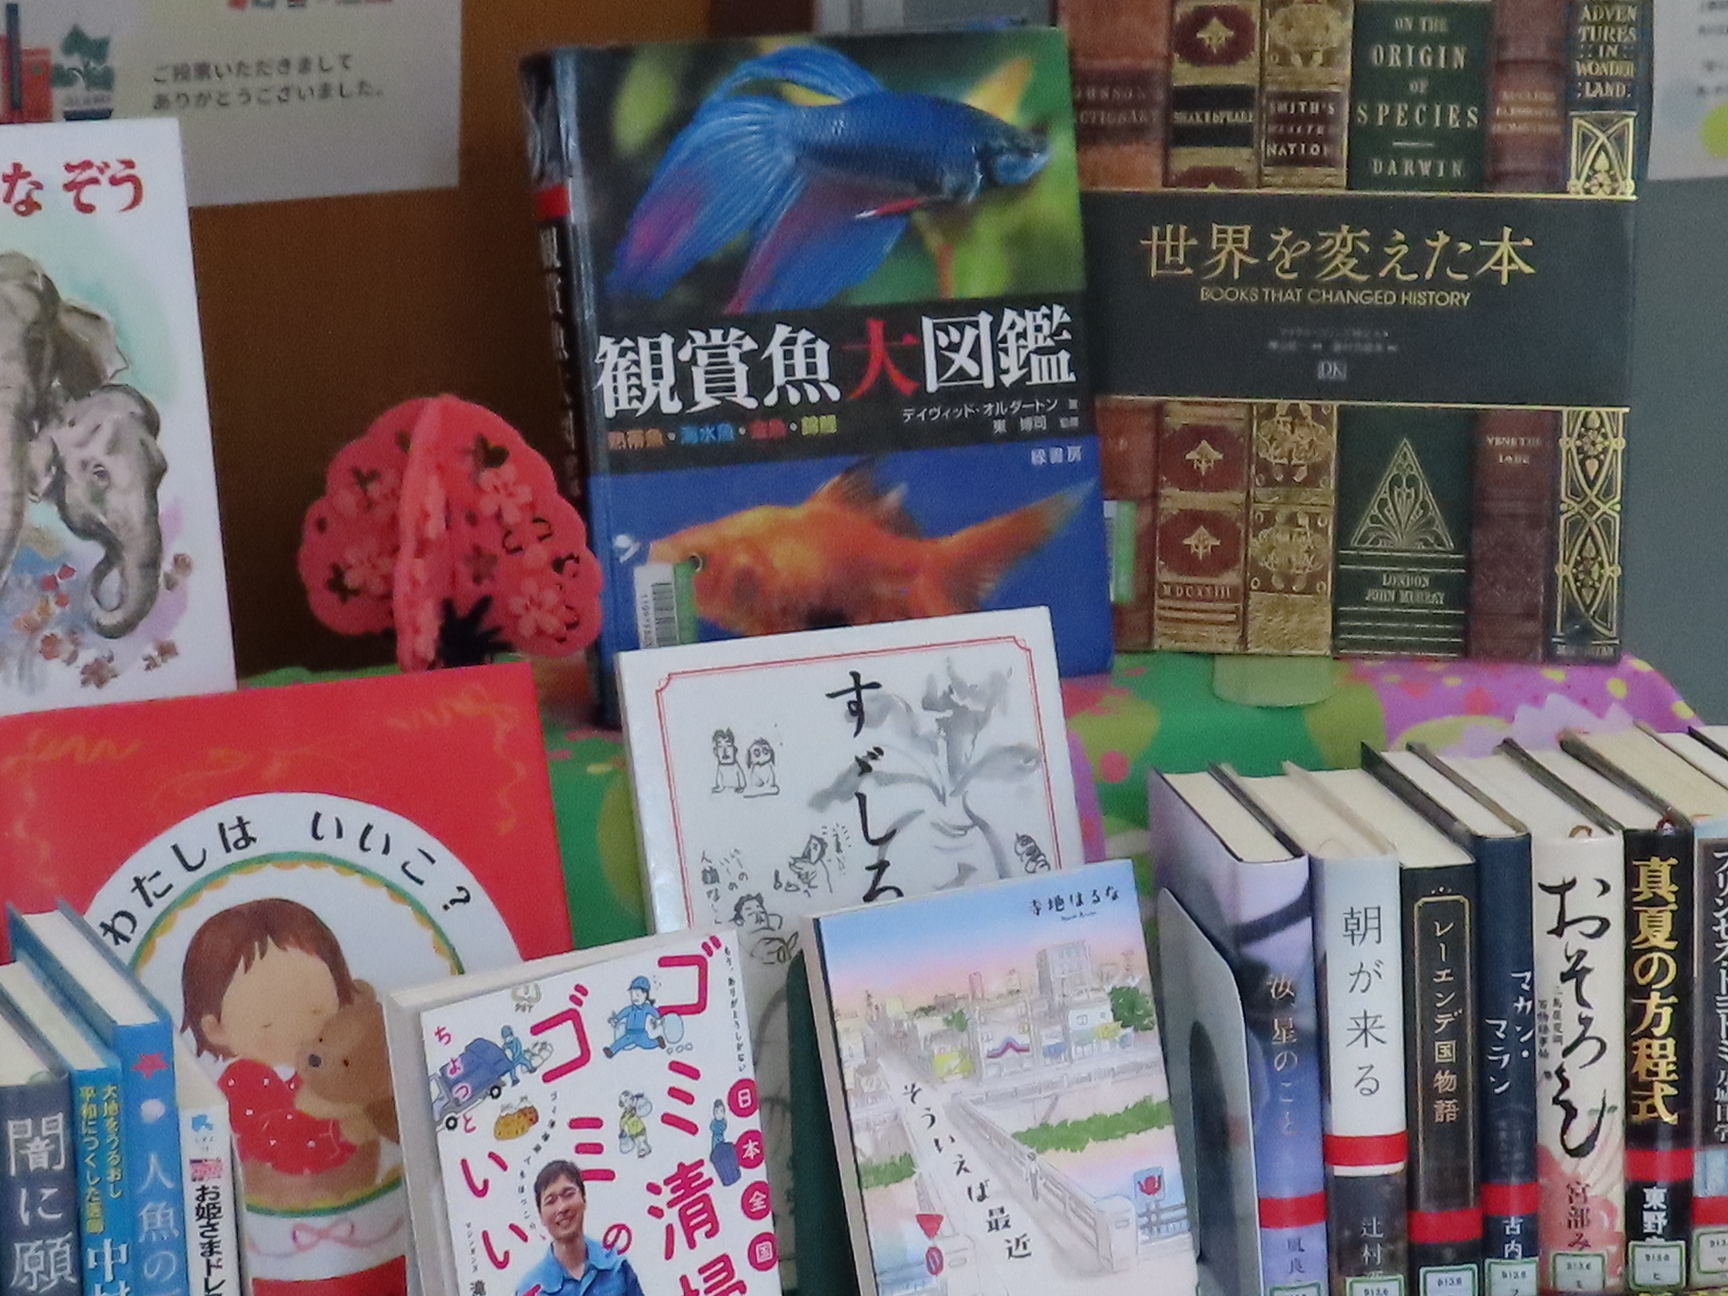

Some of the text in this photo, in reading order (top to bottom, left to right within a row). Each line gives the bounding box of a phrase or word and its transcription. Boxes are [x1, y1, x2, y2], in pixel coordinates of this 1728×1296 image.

[1373, 44, 1467, 70] ORIGIN
[1355, 102, 1480, 128] SPECIES
[63, 160, 143, 213] ぞう
[1373, 158, 1466, 179] DARWIN
[1141, 223, 1536, 286] 世界を変えた本
[1200, 285, 1471, 307] BOOKS THAT CHANGED HISTORY
[593, 304, 1077, 418] 観賞魚大図鑑
[102, 814, 257, 945] わたしは
[1030, 884, 1120, 917] 寺地はるな
[1342, 906, 1384, 1097] 朝が来る
[1432, 918, 1460, 1123] レーエンデ国物語
[1631, 856, 1679, 1124] 真夏の方程式
[728, 1078, 778, 1272] 日本全国
[900, 1080, 1033, 1262] そういえば最近
